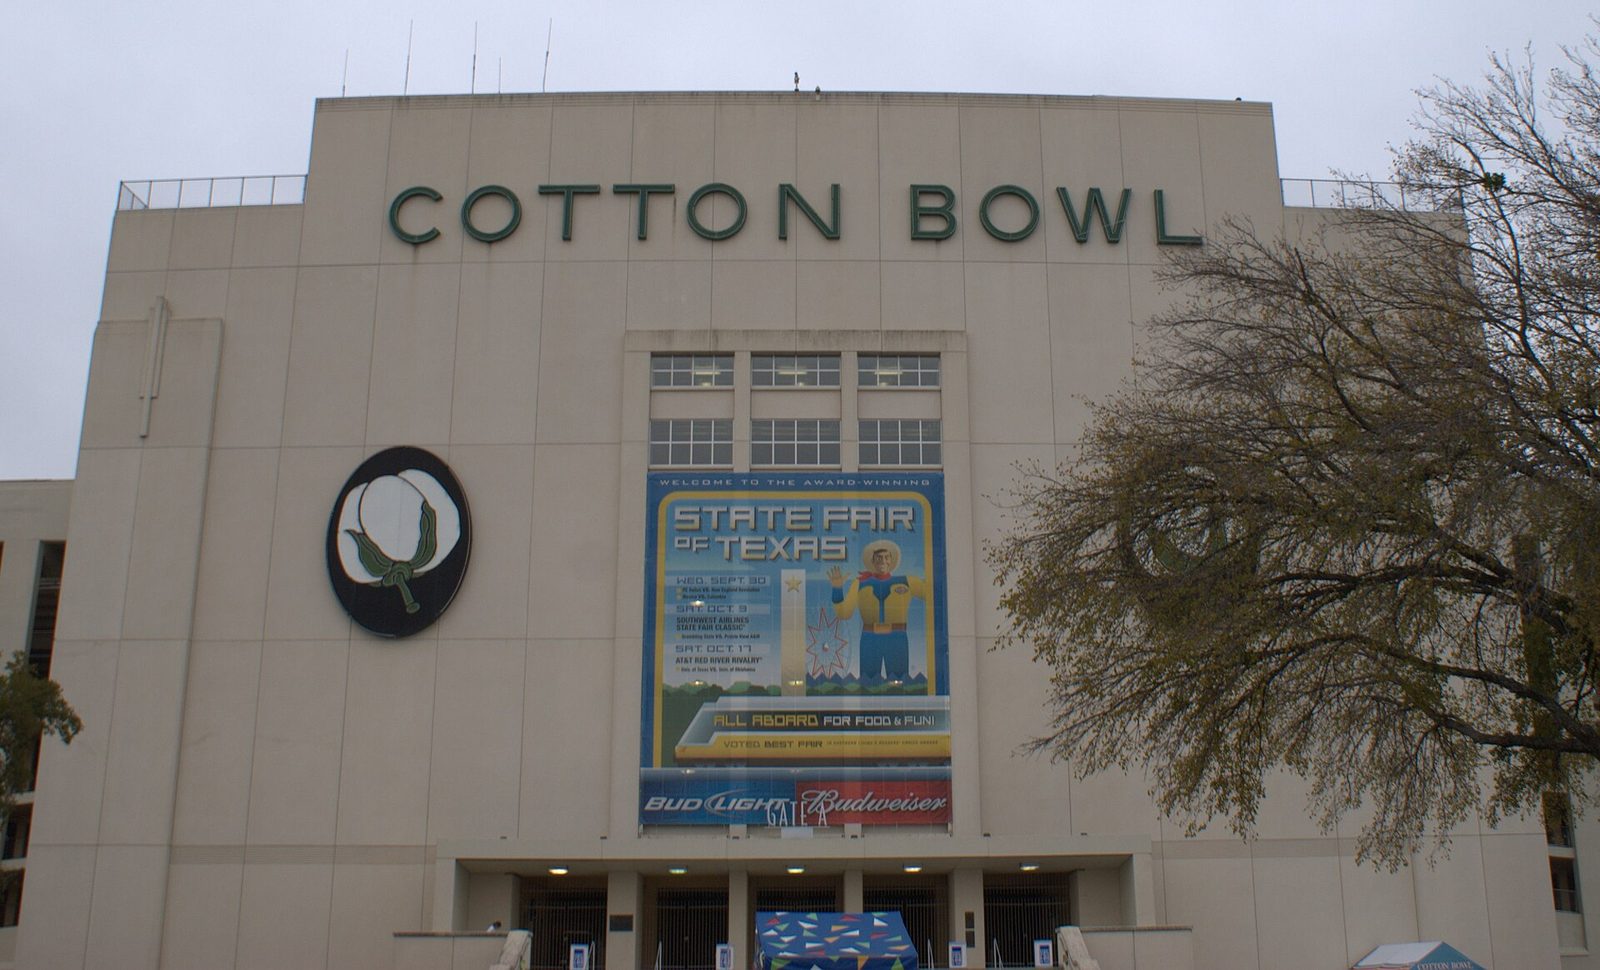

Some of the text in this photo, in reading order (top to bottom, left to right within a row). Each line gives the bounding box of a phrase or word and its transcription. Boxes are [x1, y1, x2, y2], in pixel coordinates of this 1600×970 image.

[388, 182, 1203, 245] COTTON BOWL
[674, 506, 915, 532] STATE FAIR
[674, 536, 847, 561] OF TEXAS
[676, 576, 707, 585] WED.
[710, 576, 745, 585] SEPT.
[676, 604, 703, 613] SAT.
[707, 604, 734, 613] OCT.
[676, 616, 750, 624] SOUTHWEST AIRLINES
[675, 644, 752, 653] SAT. OCT. 17
[675, 657, 693, 665] AT&T
[694, 657, 709, 665] RED
[709, 657, 731, 665] RIVER
[714, 714, 747, 727] ALL
[752, 714, 819, 727] ABOARD
[823, 715, 851, 727] FOR
[855, 715, 892, 727] FOOD
[894, 716, 902, 726] &
[723, 740, 760, 749] VOTED
[764, 740, 794, 749] BEST
[798, 740, 823, 748] FAIR
[644, 796, 790, 812] BUD LIGHT
[802, 789, 947, 814] Budweiser
[766, 801, 828, 827] GATE A
[1417, 960, 1473, 970] COTTON BOWL
